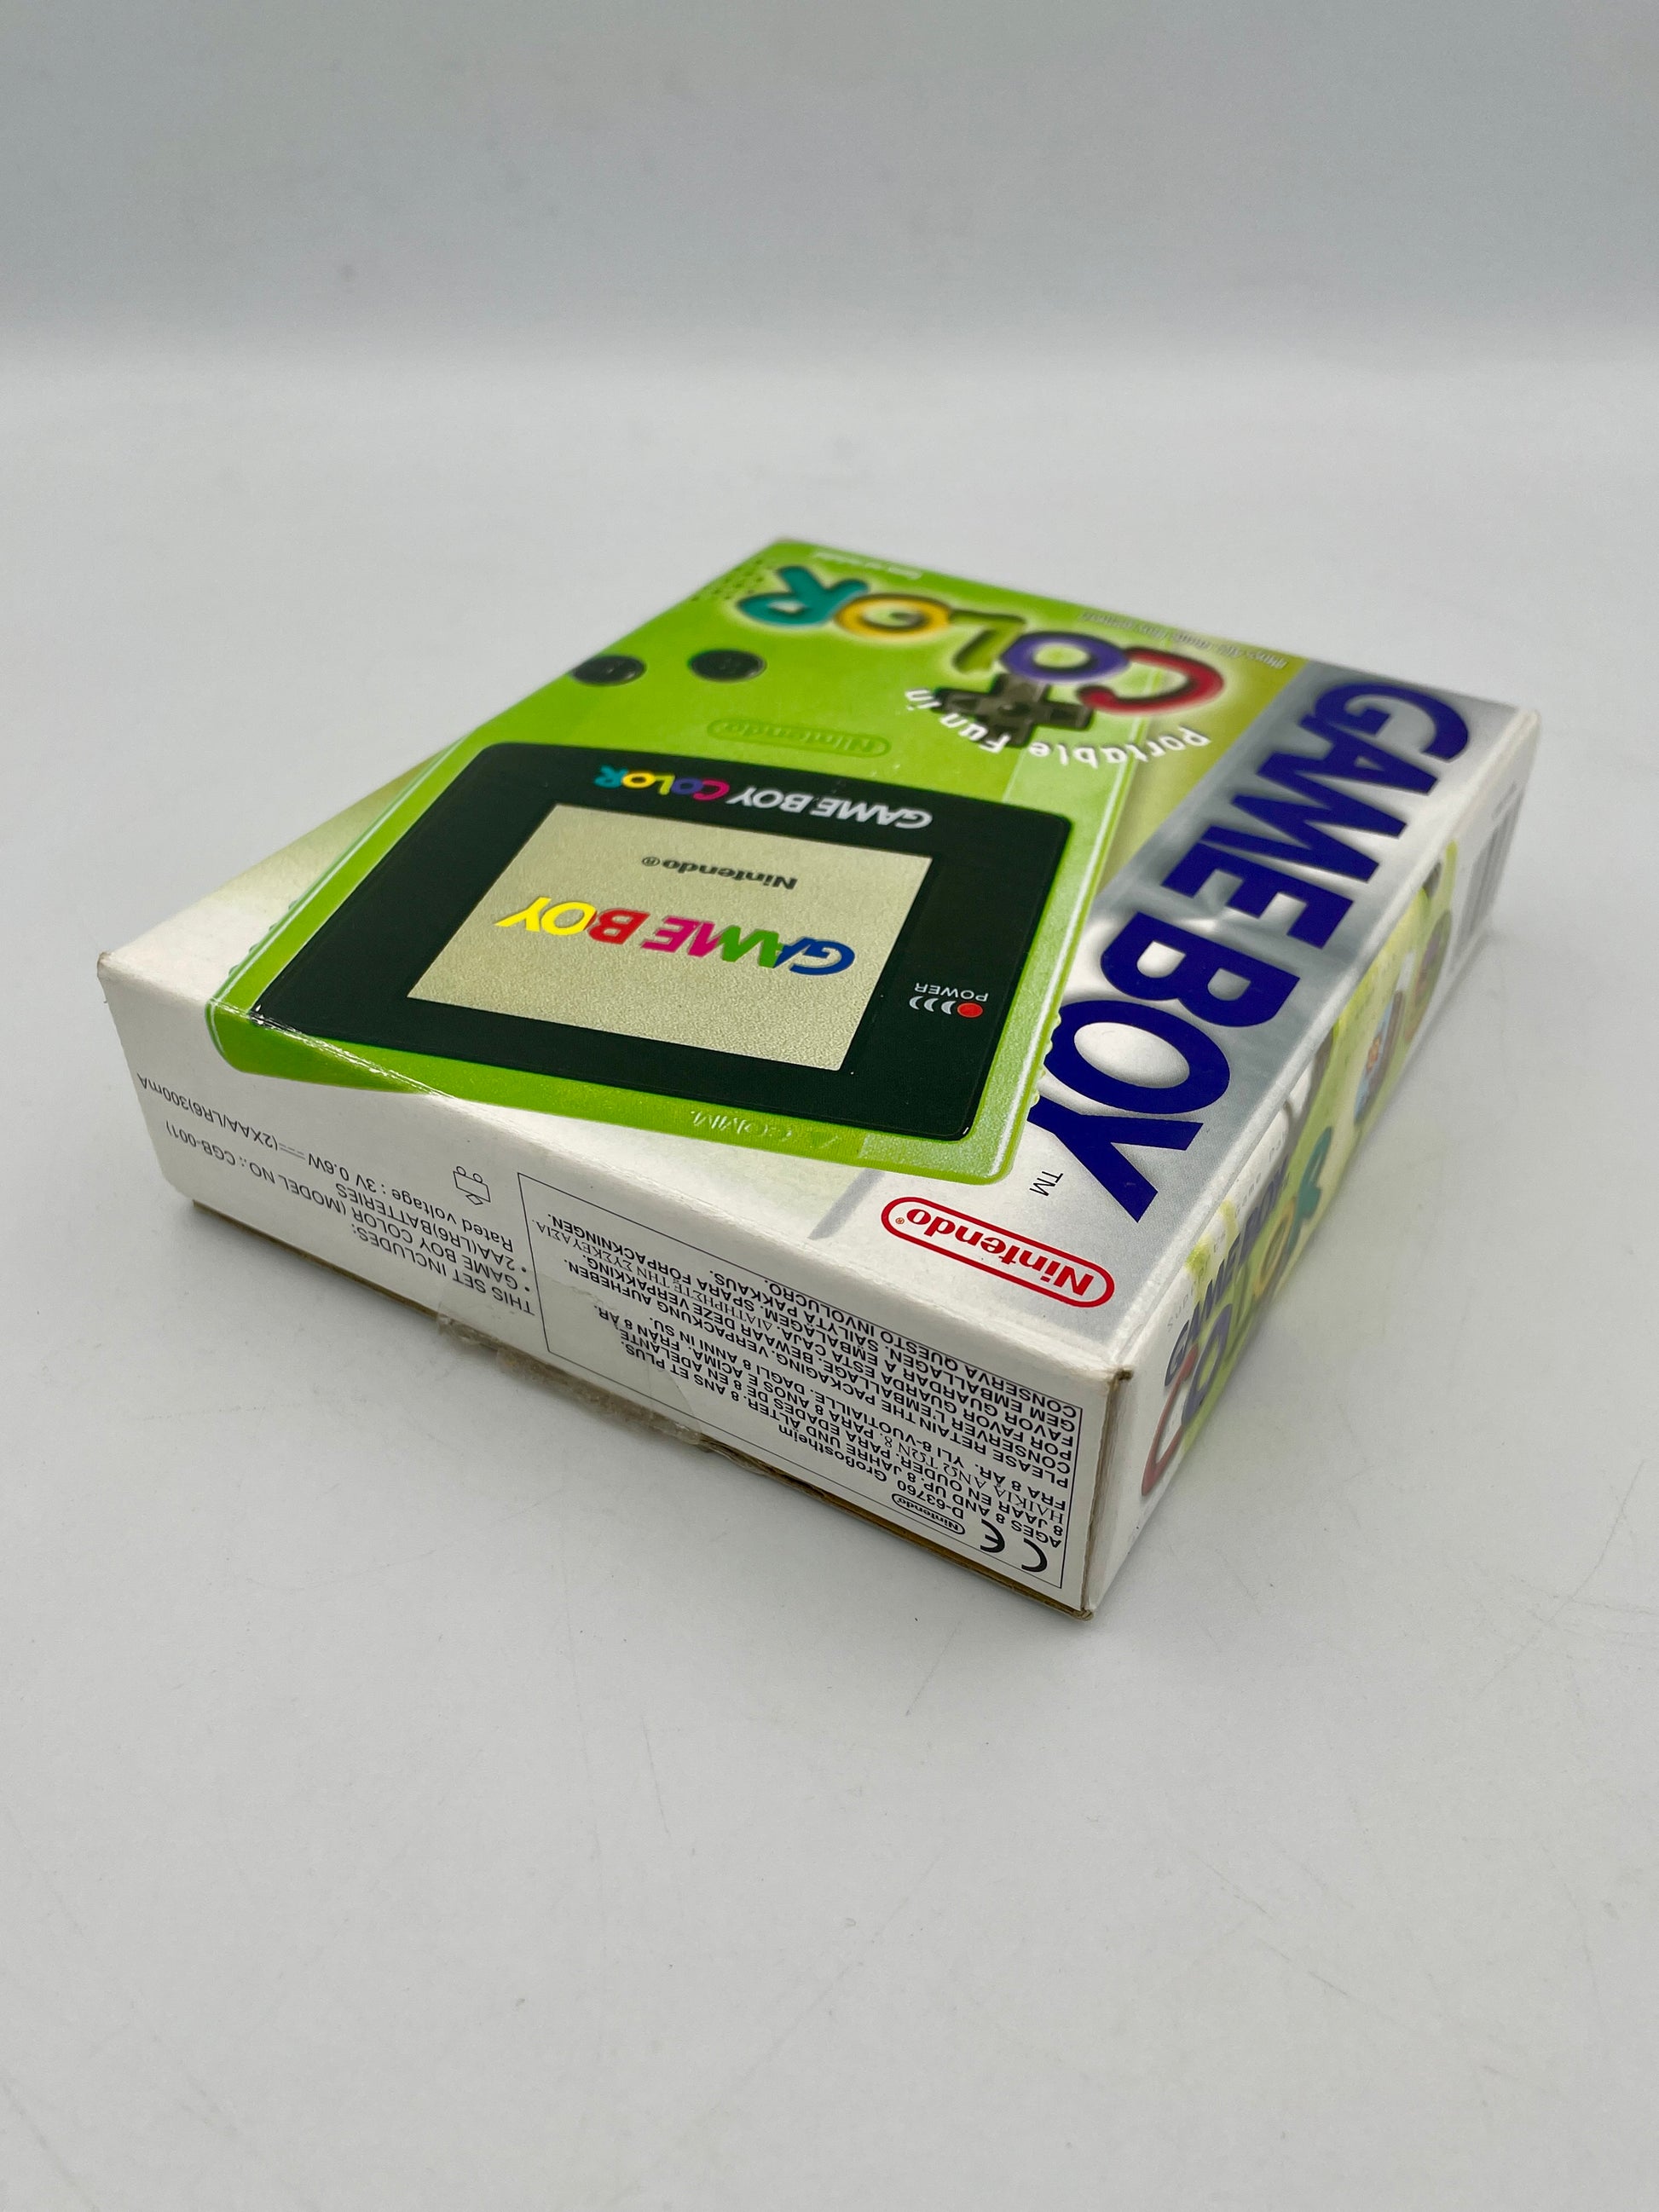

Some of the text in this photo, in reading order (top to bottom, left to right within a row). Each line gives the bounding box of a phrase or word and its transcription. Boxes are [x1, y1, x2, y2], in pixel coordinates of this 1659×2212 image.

[738, 566, 1225, 714] COLOR
[905, 687, 1211, 768] Portable Fun in
[594, 765, 933, 829] GAME BOY COLOR
[1161, 683, 1469, 950] GAME
[495, 897, 855, 975] GAME BOY
[915, 982, 989, 1002] POWER
[1026, 911, 1300, 1223] BOY
[165, 1120, 235, 1165] CGB-001)
[278, 1174, 345, 1216] (MODEL
[356, 1174, 376, 1193] 3V
[1029, 1171, 1063, 1197] TM
[391, 1188, 457, 1224] voltage
[350, 1206, 413, 1244] COLOR
[461, 1218, 513, 1252] Rated
[419, 1237, 456, 1263] BOY
[351, 1223, 535, 1315] THIS SET INCLUDES:
[461, 1254, 517, 1290] GAME
[582, 1254, 690, 1310] VERPAKKING.
[593, 1305, 620, 1328] ÅR.
[623, 1319, 633, 1330] 8
[691, 1302, 735, 1330] DEZE
[1142, 1126, 1333, 1497] COLOR
[1165, 1233, 1246, 1387] GAME
[547, 1213, 1073, 1447] FAVOR GUARDAR A EMBALAGEM. SPARA FÖRPACKNINGEN.
[636, 1324, 679, 1351] FRÅN
[740, 1323, 812, 1365] BEWAAR
[776, 1325, 826, 1356] CAJA.
[688, 1346, 743, 1378] ACIMA.
[709, 1270, 1075, 1432] GEM EMBALLAGEN. SÄILYTÄ PAKKAUS.
[764, 1279, 1076, 1418] CONSERVA QUESTO INVOLUCRO.
[831, 1349, 875, 1378] ESTA
[564, 1259, 1068, 1488] PLEASE RETAIN THE PACKAGING. VERPACKUNG AUFHEBEN.
[707, 1366, 729, 1385] EN
[732, 1379, 742, 1390] 8
[747, 1372, 758, 1387] E
[746, 1384, 768, 1403] DE
[762, 1380, 809, 1408] ANOS
[814, 1404, 824, 1415] 8
[880, 1371, 957, 1413] GUARDA
[649, 1317, 1066, 1510] FRA 8 ÅR. YLI 8-VUOTIAILLE. DAGLI 8 ANNI IN SU.
[772, 1397, 840, 1436] EDADES
[828, 1409, 873, 1439] PARA
[962, 1407, 1023, 1442] FAVOR
[621, 1341, 1061, 1548] AGES 8 AND UP. 8 JAHRE UND ÄLTER. 8 ANS ET PLUS.
[845, 1429, 890, 1459] PARA
[879, 1432, 893, 1447] 8.
[951, 1417, 1070, 1474] CONSERVER
[1030, 1435, 1072, 1461] POR
[777, 1424, 963, 1520] D-63760 Großostheim
[895, 1453, 962, 1492] OUDER.
[899, 1497, 960, 1531] Nintendo
[968, 1487, 991, 1506] EN
[997, 1499, 1048, 1528] JAAR
[1053, 1524, 1063, 1536] 8
